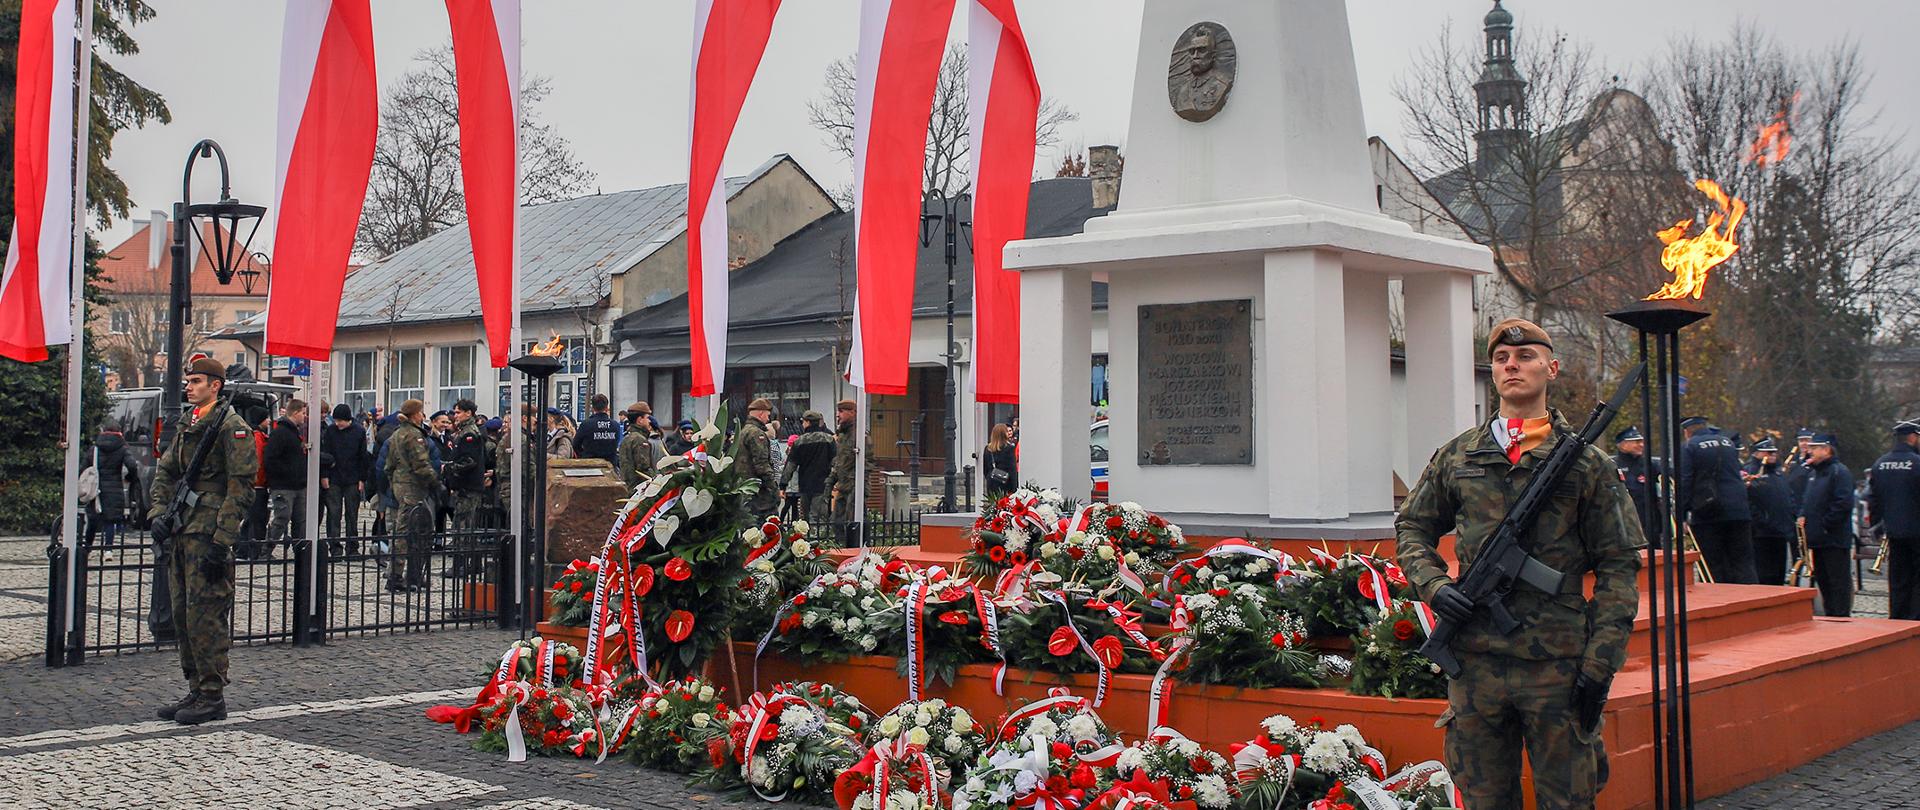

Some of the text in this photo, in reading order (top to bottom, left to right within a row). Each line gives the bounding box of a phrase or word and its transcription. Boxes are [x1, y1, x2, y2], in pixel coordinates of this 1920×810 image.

[597, 421, 611, 429] GRYF
[593, 431, 617, 440] KRAŚNIK
[1879, 460, 1913, 470] STRAŻ
[909, 606, 920, 634] SEJM
[910, 640, 920, 655] NA
